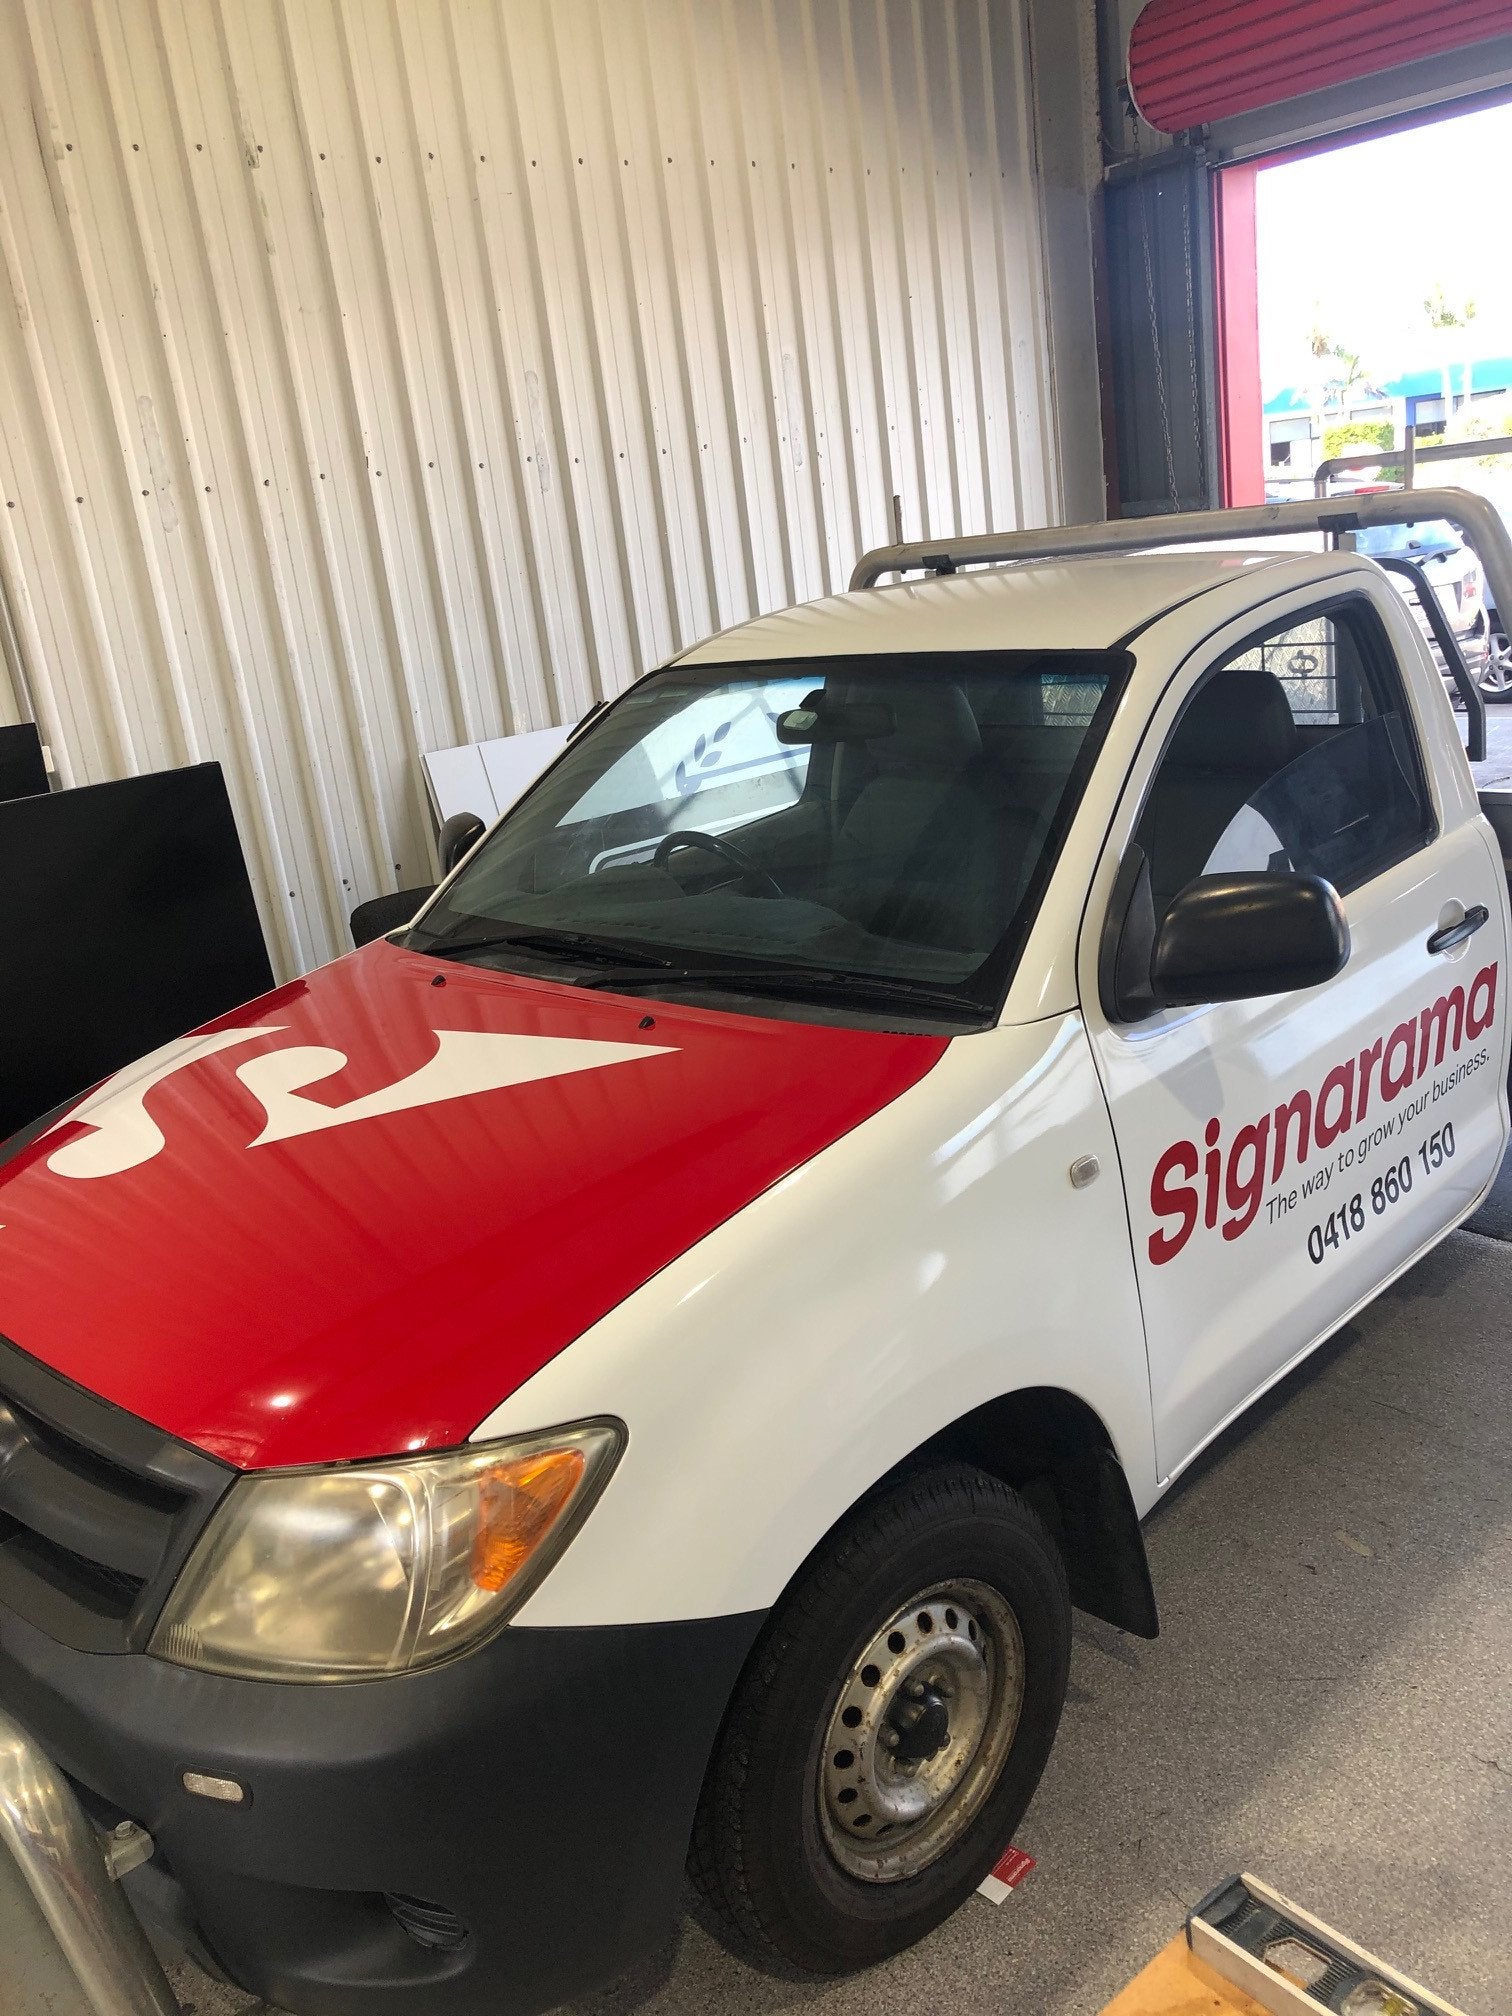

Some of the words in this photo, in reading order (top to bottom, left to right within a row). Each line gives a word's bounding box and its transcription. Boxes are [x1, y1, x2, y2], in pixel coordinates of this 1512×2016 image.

[1148, 961, 1498, 1265] Signarama
[1265, 1189, 1298, 1225] The
[1301, 1162, 1335, 1200] way
[1337, 1149, 1355, 1173] to
[1358, 1118, 1395, 1164] grow
[1397, 1091, 1430, 1135] your
[1432, 1047, 1490, 1103] business.
[1308, 1193, 1366, 1265] 0418
[1371, 1156, 1413, 1215] 860
[1418, 1122, 1456, 1176] 150
